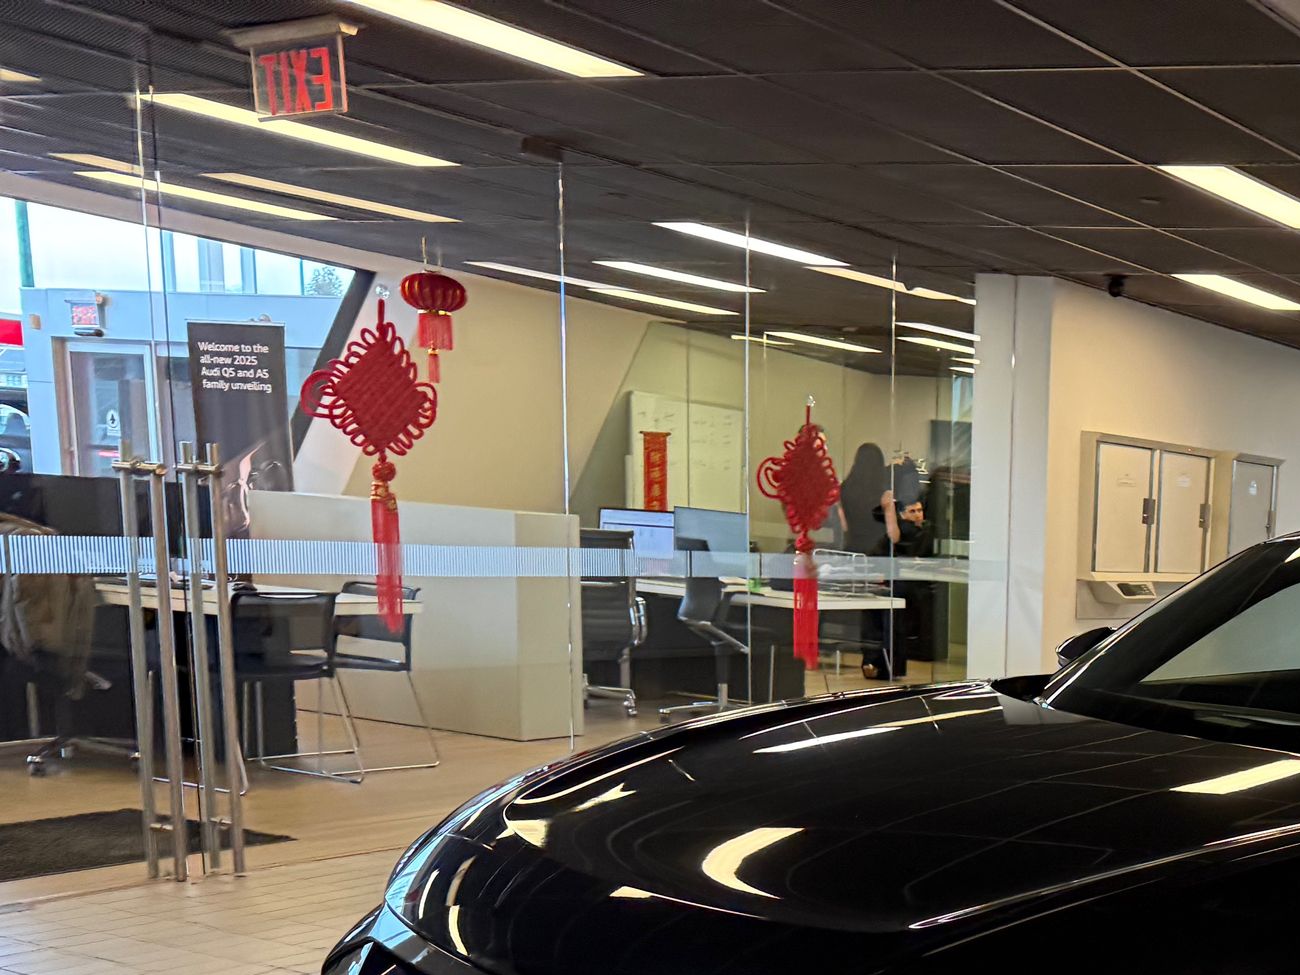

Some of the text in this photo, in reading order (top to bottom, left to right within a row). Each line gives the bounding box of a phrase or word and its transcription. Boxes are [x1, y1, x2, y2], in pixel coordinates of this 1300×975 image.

[197, 342, 269, 353] Welcome to the
[199, 354, 258, 365] all-new 2025
[201, 367, 269, 379] Audi Q5 and A5
[202, 379, 272, 393] family unveiling
